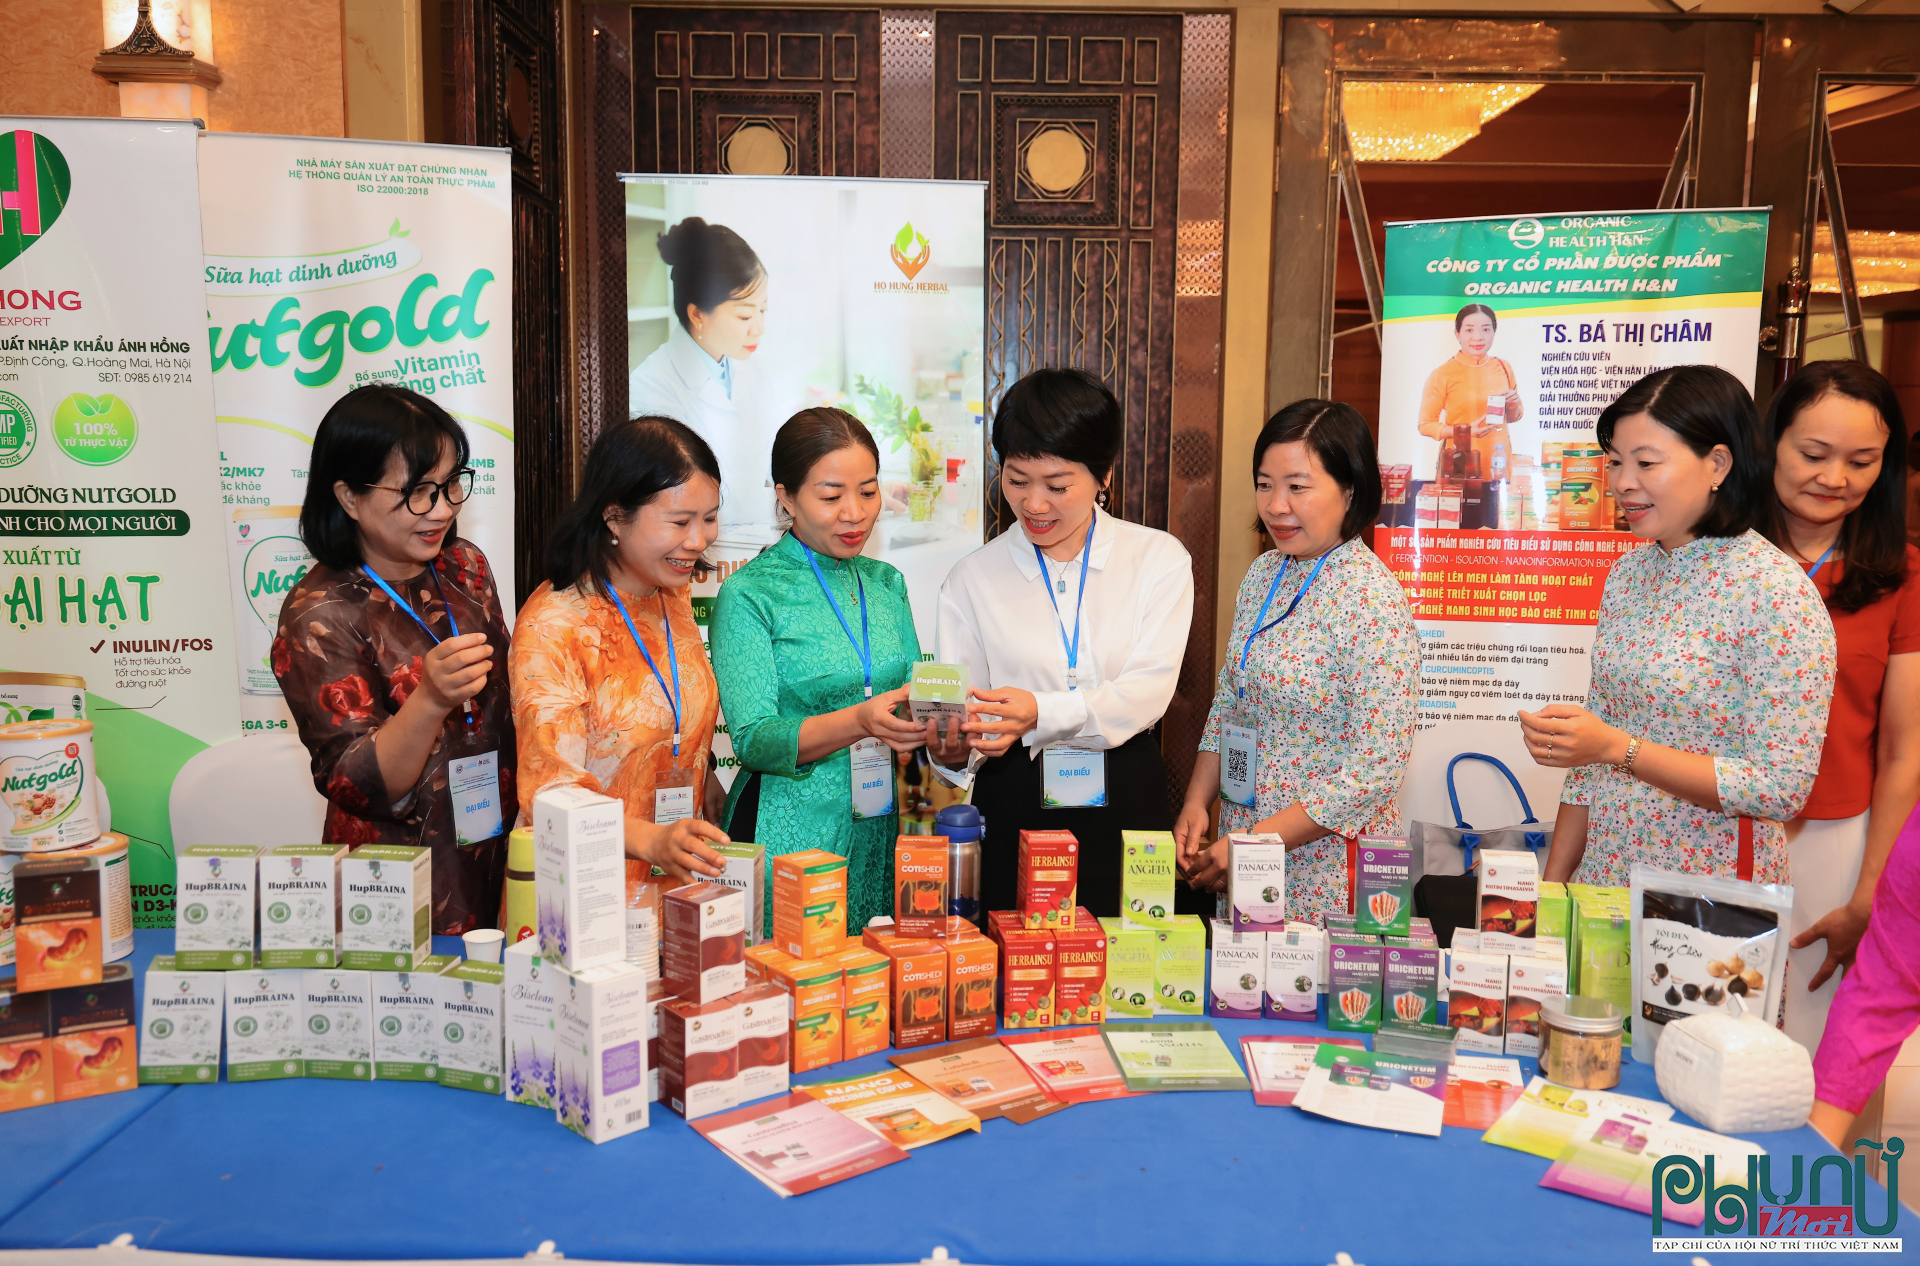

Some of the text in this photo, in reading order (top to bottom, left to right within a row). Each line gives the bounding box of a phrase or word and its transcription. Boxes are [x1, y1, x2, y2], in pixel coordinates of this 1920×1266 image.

[357, 184, 429, 197] ISO 22000:2018
[1561, 215, 1632, 231] ORGANIC
[1548, 231, 1644, 249] HEALTH H&N
[1426, 247, 1722, 274] CÔNG TY CỔ PHẦN DƯỢC PHẨM
[204, 264, 243, 285] Sữa
[249, 267, 283, 286] hạt
[336, 250, 398, 277] dưỡng
[873, 281, 950, 292] HO HUNG HERBAL
[1464, 278, 1679, 296] ORGANIC HEALTH H&N
[208, 268, 495, 389] utgold
[1542, 318, 1712, 348] TS. BÁ THỊ CHÂM
[29, 335, 191, 355] NHẬP KHẨU ÁNH HỒNG
[395, 349, 481, 377] Vitamin
[1541, 350, 1611, 362] NGHIÊN CỨU VIÊN
[31, 356, 191, 371] Công, Q.Hoàng Mai, Hà Nội
[98, 372, 192, 385] SĐT: 0985 619 214
[355, 368, 399, 384] Bổ sung
[73, 422, 118, 437] 100%
[1538, 416, 1594, 432] TẠI HÀN QUỐC
[64, 436, 129, 449] TỪ THỰC VẬT
[72, 486, 177, 505] NUTGOLD
[25, 512, 177, 534] CHO MỌI NGƯỜI
[3, 545, 81, 566] XUẤT TỪ
[1420, 570, 1445, 584] NGHỆ
[1447, 571, 1464, 583] LÊN
[1466, 573, 1487, 584] MEN
[1490, 571, 1511, 585] LÀM
[1514, 571, 1538, 586] TĂNG
[1541, 575, 1567, 588] HOẠT
[1569, 572, 1593, 587] CHẤT
[1420, 585, 1547, 604] NGHỆ TRIẾT XUẤT CHỌN LỌC
[59, 574, 161, 631] HẠT
[112, 637, 214, 655] INULIN/FOS
[1428, 641, 1588, 656] giảm các triệu chứng rối loạn tiêu hoá.
[114, 655, 182, 668] Hỗ trợ tiêu hóa
[114, 665, 191, 678] Tốt cho sức khỏe
[1425, 665, 1495, 676] CURCUMINCOPTIS
[115, 677, 167, 691] đường ruột
[916, 676, 963, 688] HupBRAINA
[1, 759, 78, 793] Nutgold
[1031, 855, 1075, 868] HERBAINSU
[1238, 863, 1281, 873] PANACAN
[901, 865, 943, 874] COTISHEDI
[1363, 864, 1409, 875] URICNETUM
[185, 882, 247, 893] HupBRAINA
[268, 881, 328, 892] HupBRAINA
[349, 884, 406, 896] HupBRAINA
[1008, 953, 1053, 967] HERBAINSU
[1059, 951, 1104, 965] HERBAINSU
[1216, 950, 1259, 960] PANACAN
[1271, 952, 1315, 962] PANACAN
[956, 963, 994, 976] COTISHEDI
[1333, 962, 1380, 972] URICNETUM
[1388, 963, 1435, 976] URICNETUM
[902, 970, 943, 983] COTISHEDI
[151, 997, 216, 1008] HupBRAINA
[233, 992, 296, 1006] HupBRAINA
[308, 994, 364, 1005] HupBRAINA
[379, 995, 435, 1006] HupBRAINA
[444, 1001, 495, 1018] HupBRAINA
[1375, 1061, 1437, 1075] URICNETUM
[823, 1077, 894, 1098] NANO
[876, 1081, 914, 1097] COPTIS
